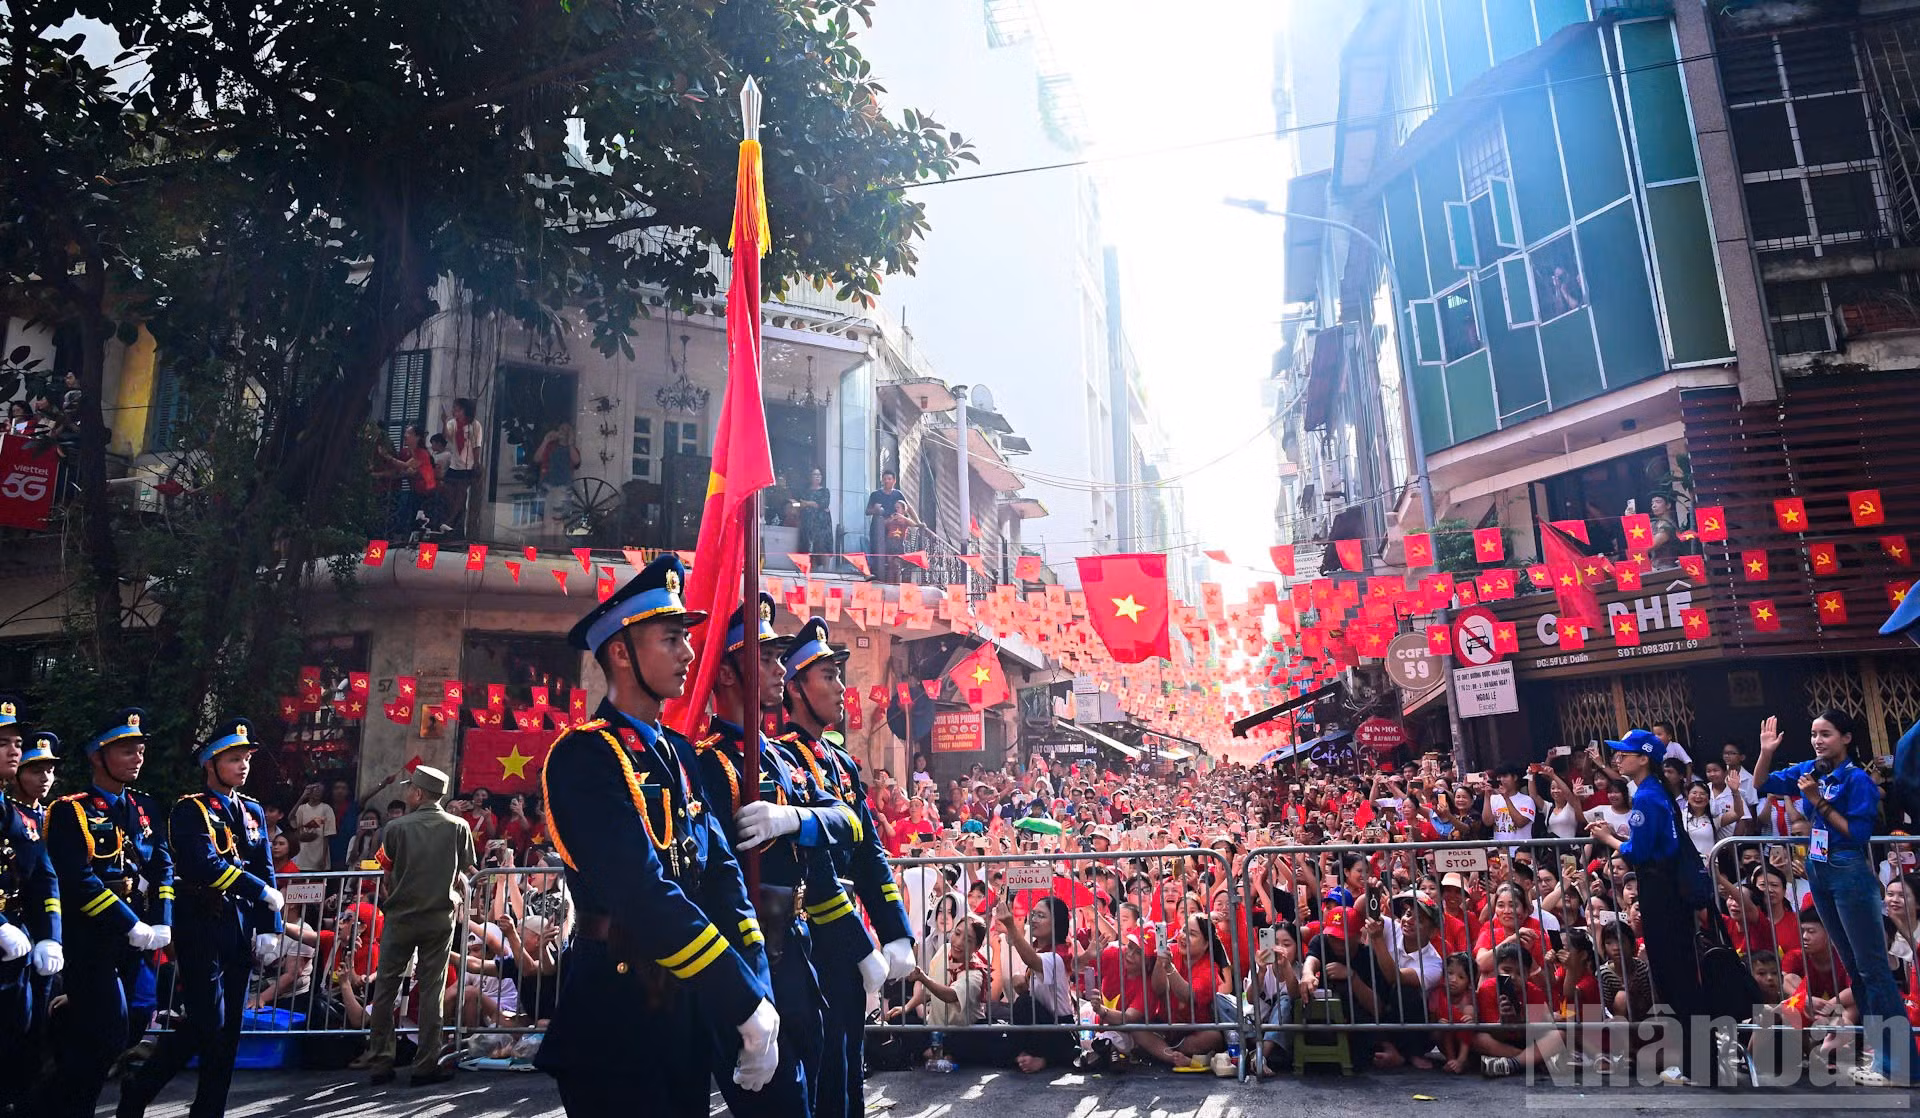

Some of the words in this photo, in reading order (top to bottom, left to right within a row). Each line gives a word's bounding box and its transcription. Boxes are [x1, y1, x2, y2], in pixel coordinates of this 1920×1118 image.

[13, 464, 49, 476] viettel
[1, 472, 49, 502] 5G
[1403, 660, 1430, 680] 59
[377, 678, 393, 692] 57
[1445, 859, 1477, 868] STOP
[1008, 874, 1034, 884] DỪNG
